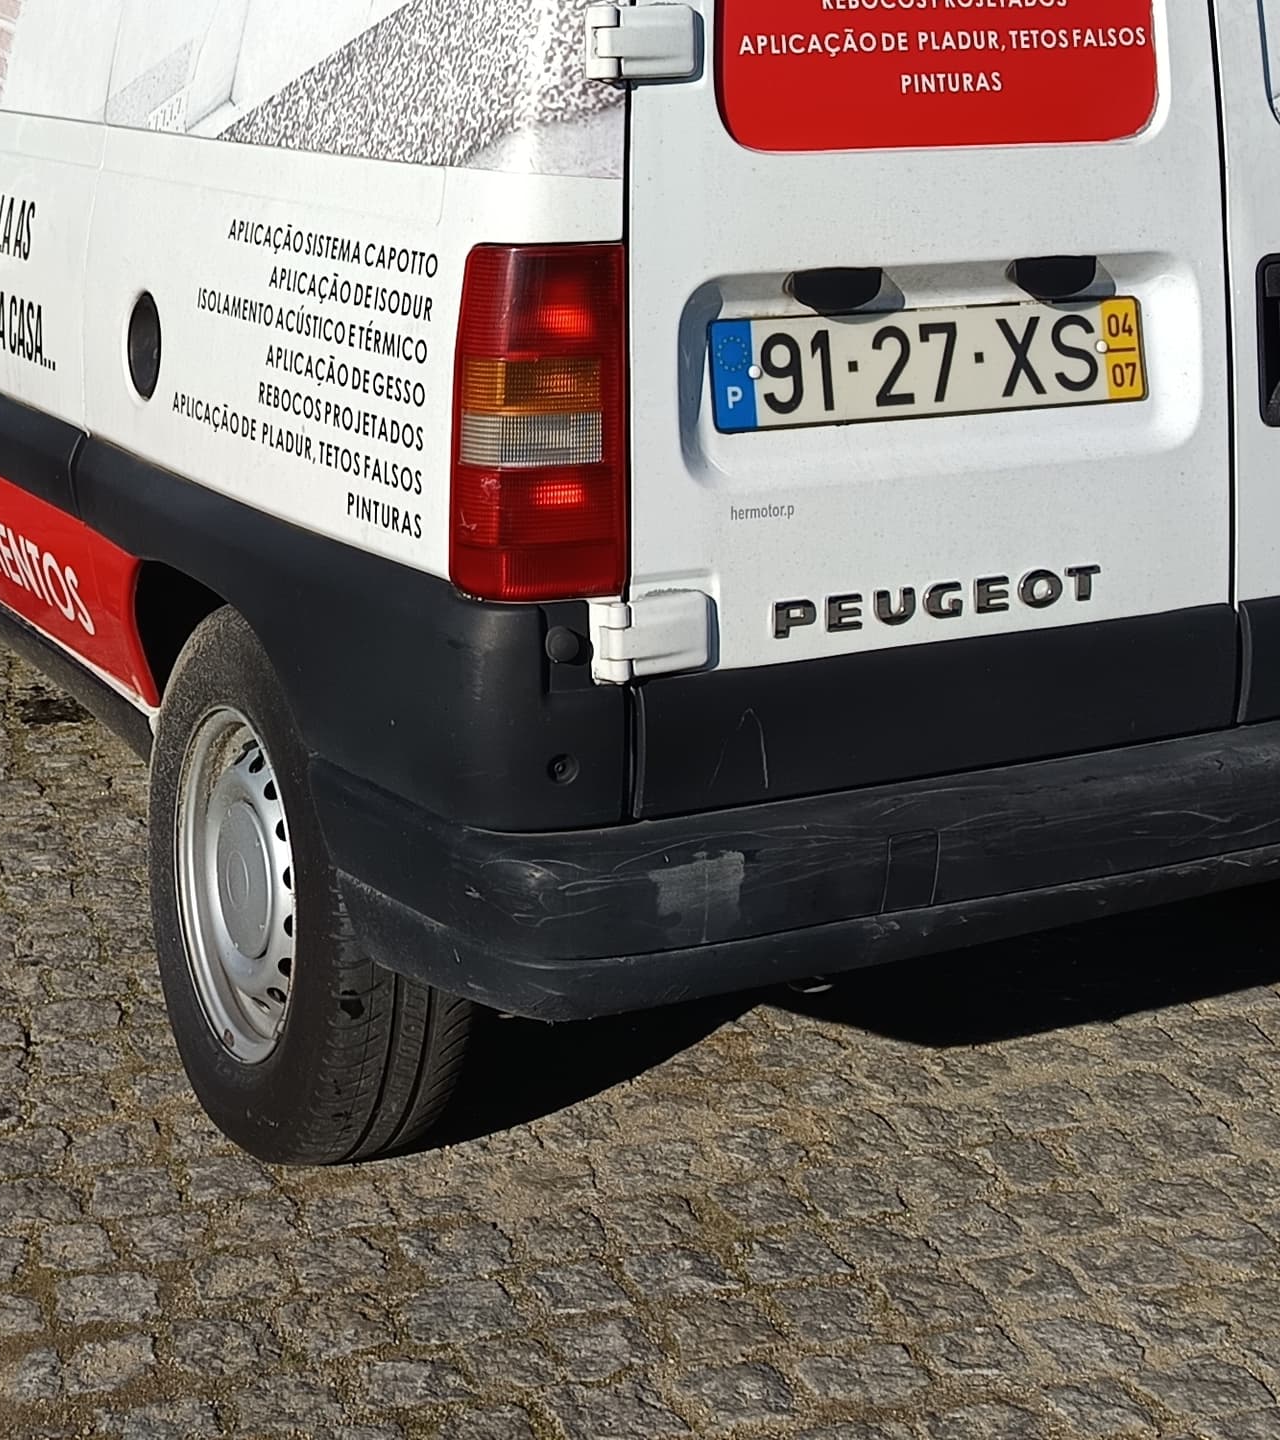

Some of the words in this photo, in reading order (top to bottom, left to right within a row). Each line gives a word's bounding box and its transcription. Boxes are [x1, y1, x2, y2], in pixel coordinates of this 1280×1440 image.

[739, 28, 877, 57] APLICAÇÃO
[881, 32, 908, 52] DE
[918, 30, 1006, 53] PLADUR,
[1009, 29, 1068, 50] TETOS
[1072, 27, 1146, 47] FALSOS
[901, 72, 1002, 94] PINTURAS
[13, 200, 35, 260] AS
[228, 218, 303, 254] APLICAÇÃO
[305, 232, 361, 265] SISTEMA
[364, 242, 438, 278] CAPOTTO
[268, 266, 351, 304] APLICAÇÃO
[353, 283, 372, 310] DE
[374, 286, 433, 322] ISODUR
[197, 287, 273, 326] ISOLAMENTO
[275, 306, 345, 345] ACÚSTICO
[348, 323, 356, 347] E
[357, 320, 428, 364] TÉRMICO
[265, 345, 349, 387] APLICAÇÃO
[351, 369, 370, 394] DE
[373, 371, 426, 408] GESSO
[727, 386, 743, 409] P
[1107, 313, 1133, 338] 04
[1111, 362, 1136, 388] 07
[172, 392, 239, 434] APLICAÇÃO
[241, 414, 257, 440] DE
[261, 422, 317, 464] PLADUR,
[319, 440, 361, 478] TETOS
[363, 454, 422, 495] FALSOS
[258, 382, 321, 422] REBOCOS
[324, 403, 424, 452] PROJETADOS
[347, 491, 422, 539] PINTURAS
[730, 504, 795, 521] hermotor.p
[772, 563, 1101, 639] PEUGEOT
